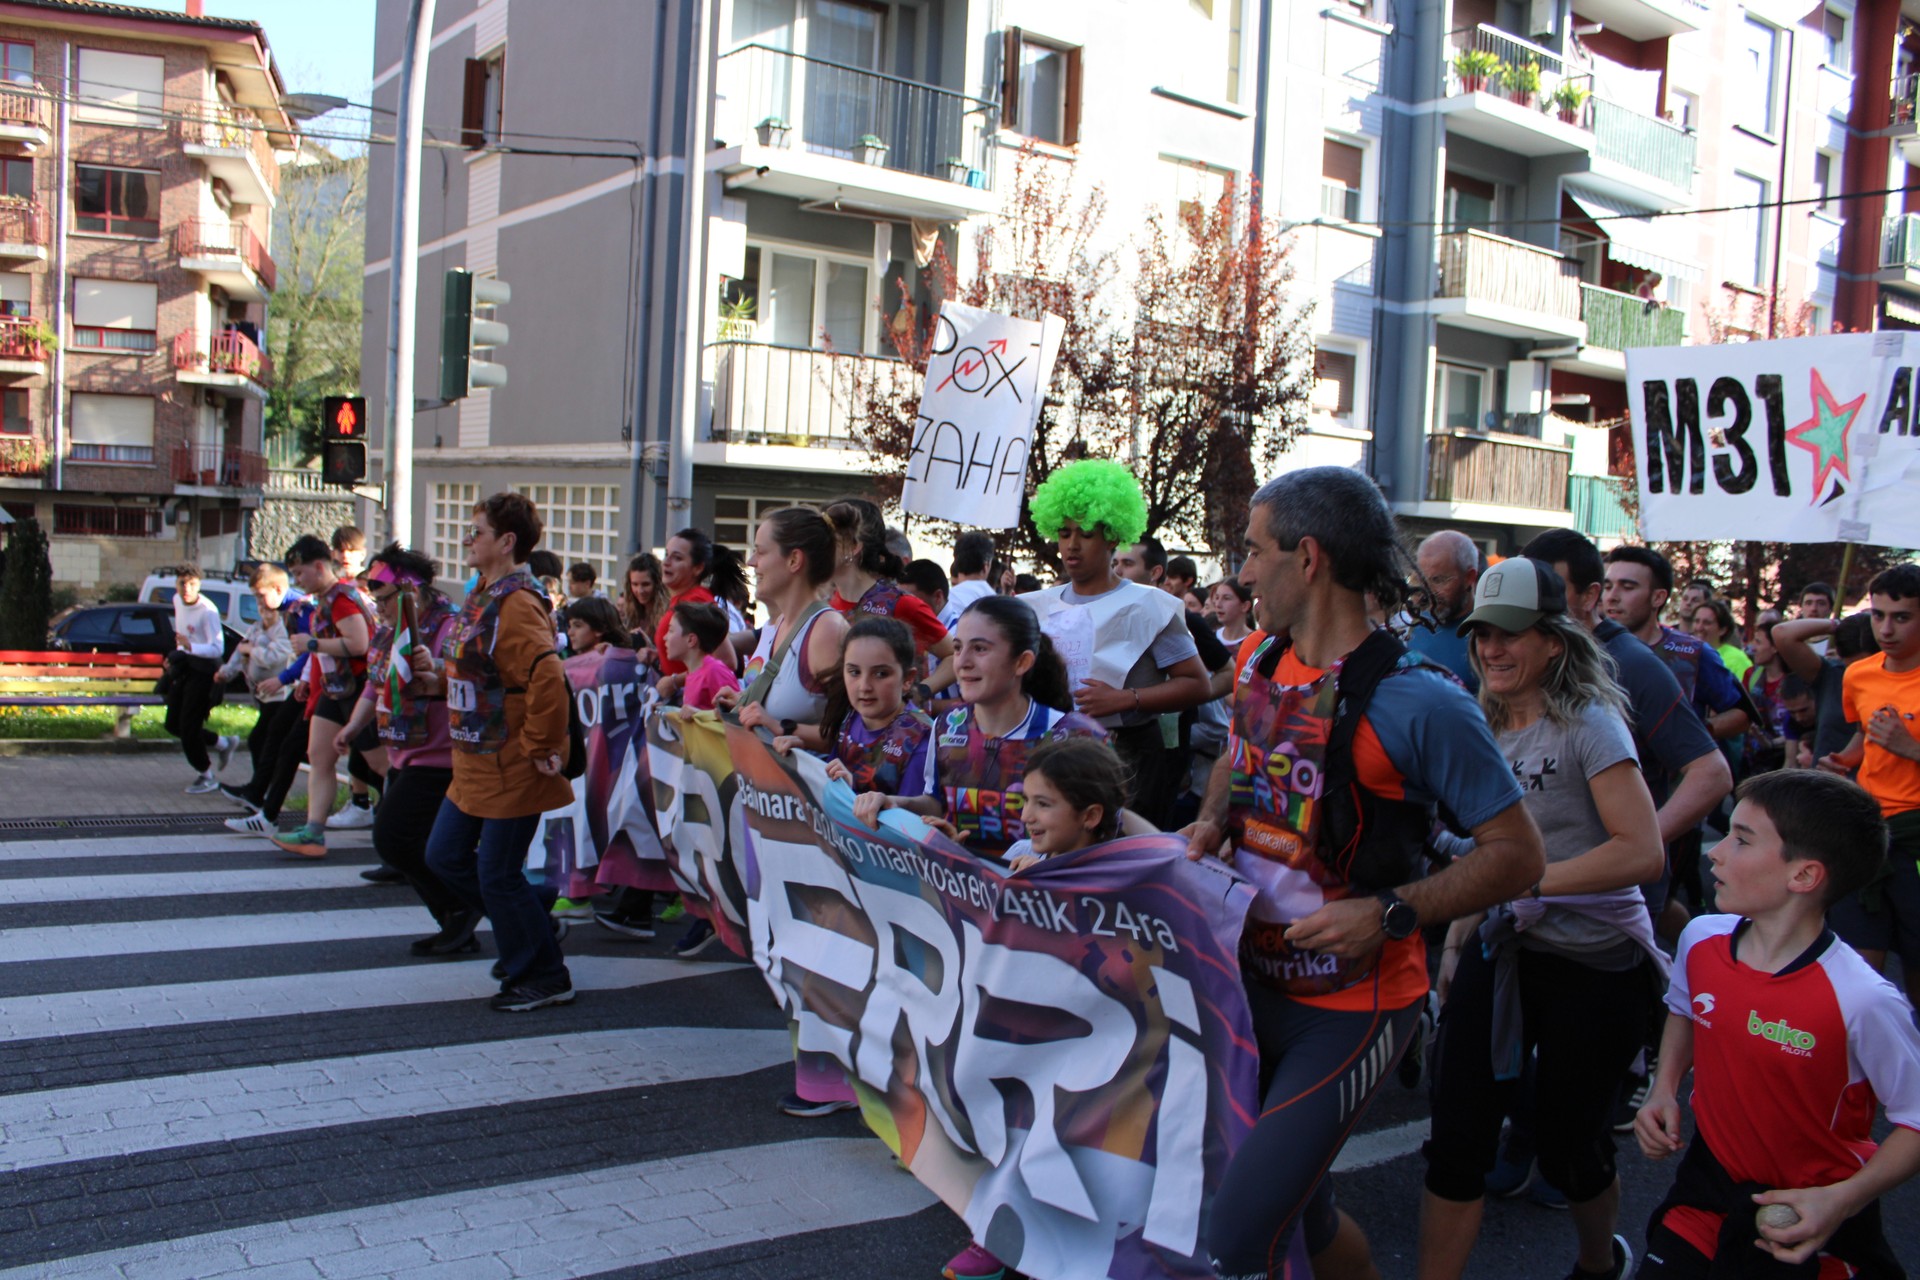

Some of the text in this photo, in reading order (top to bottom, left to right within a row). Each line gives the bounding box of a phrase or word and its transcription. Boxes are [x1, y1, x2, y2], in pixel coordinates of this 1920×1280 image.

[1643, 374, 1791, 497] M31
[1675, 644, 1695, 654] eitb
[866, 841, 992, 911] martxoaren
[1081, 896, 1179, 953] 24ra
[1748, 1010, 1816, 1050] baiko
[1781, 1045, 1812, 1057] PILOTA
